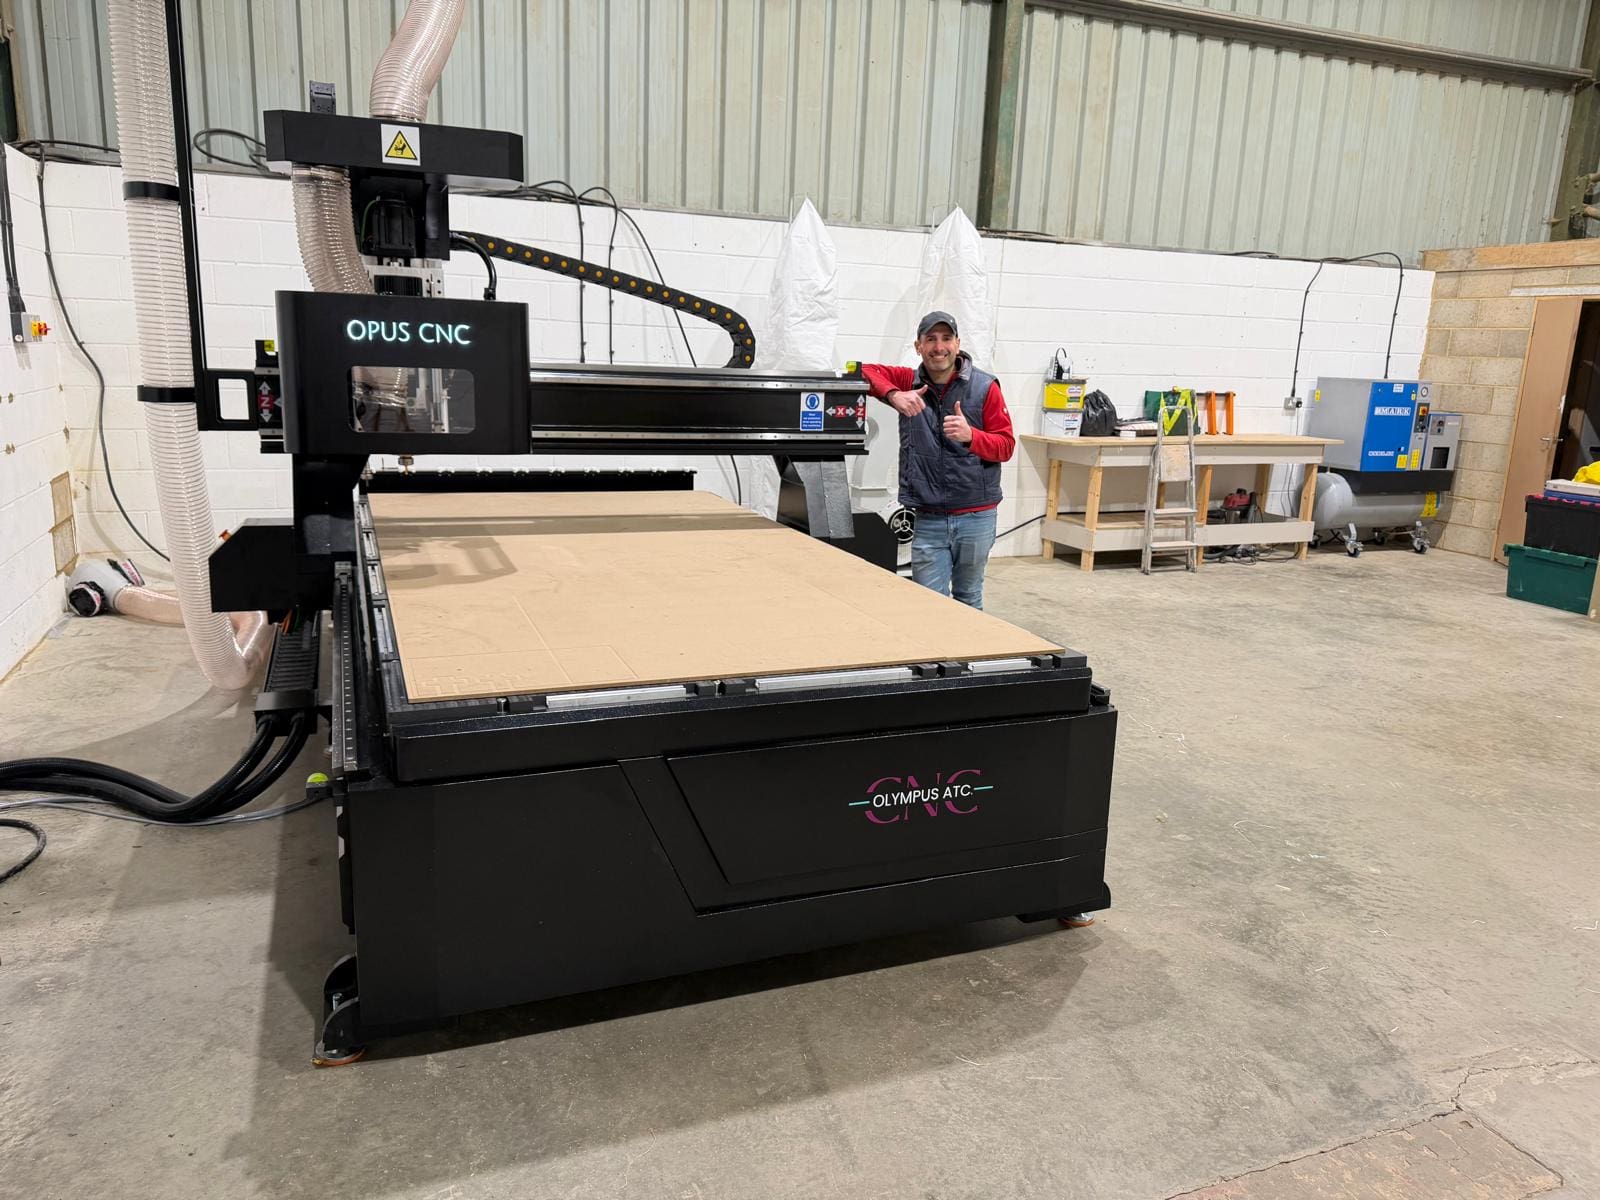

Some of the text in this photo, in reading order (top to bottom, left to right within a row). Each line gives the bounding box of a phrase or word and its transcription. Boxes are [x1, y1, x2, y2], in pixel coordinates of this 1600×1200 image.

[347, 319, 472, 345] OPUS CNC
[837, 407, 845, 415] X
[857, 407, 864, 415] Z
[873, 788, 939, 808] OLYMPUS
